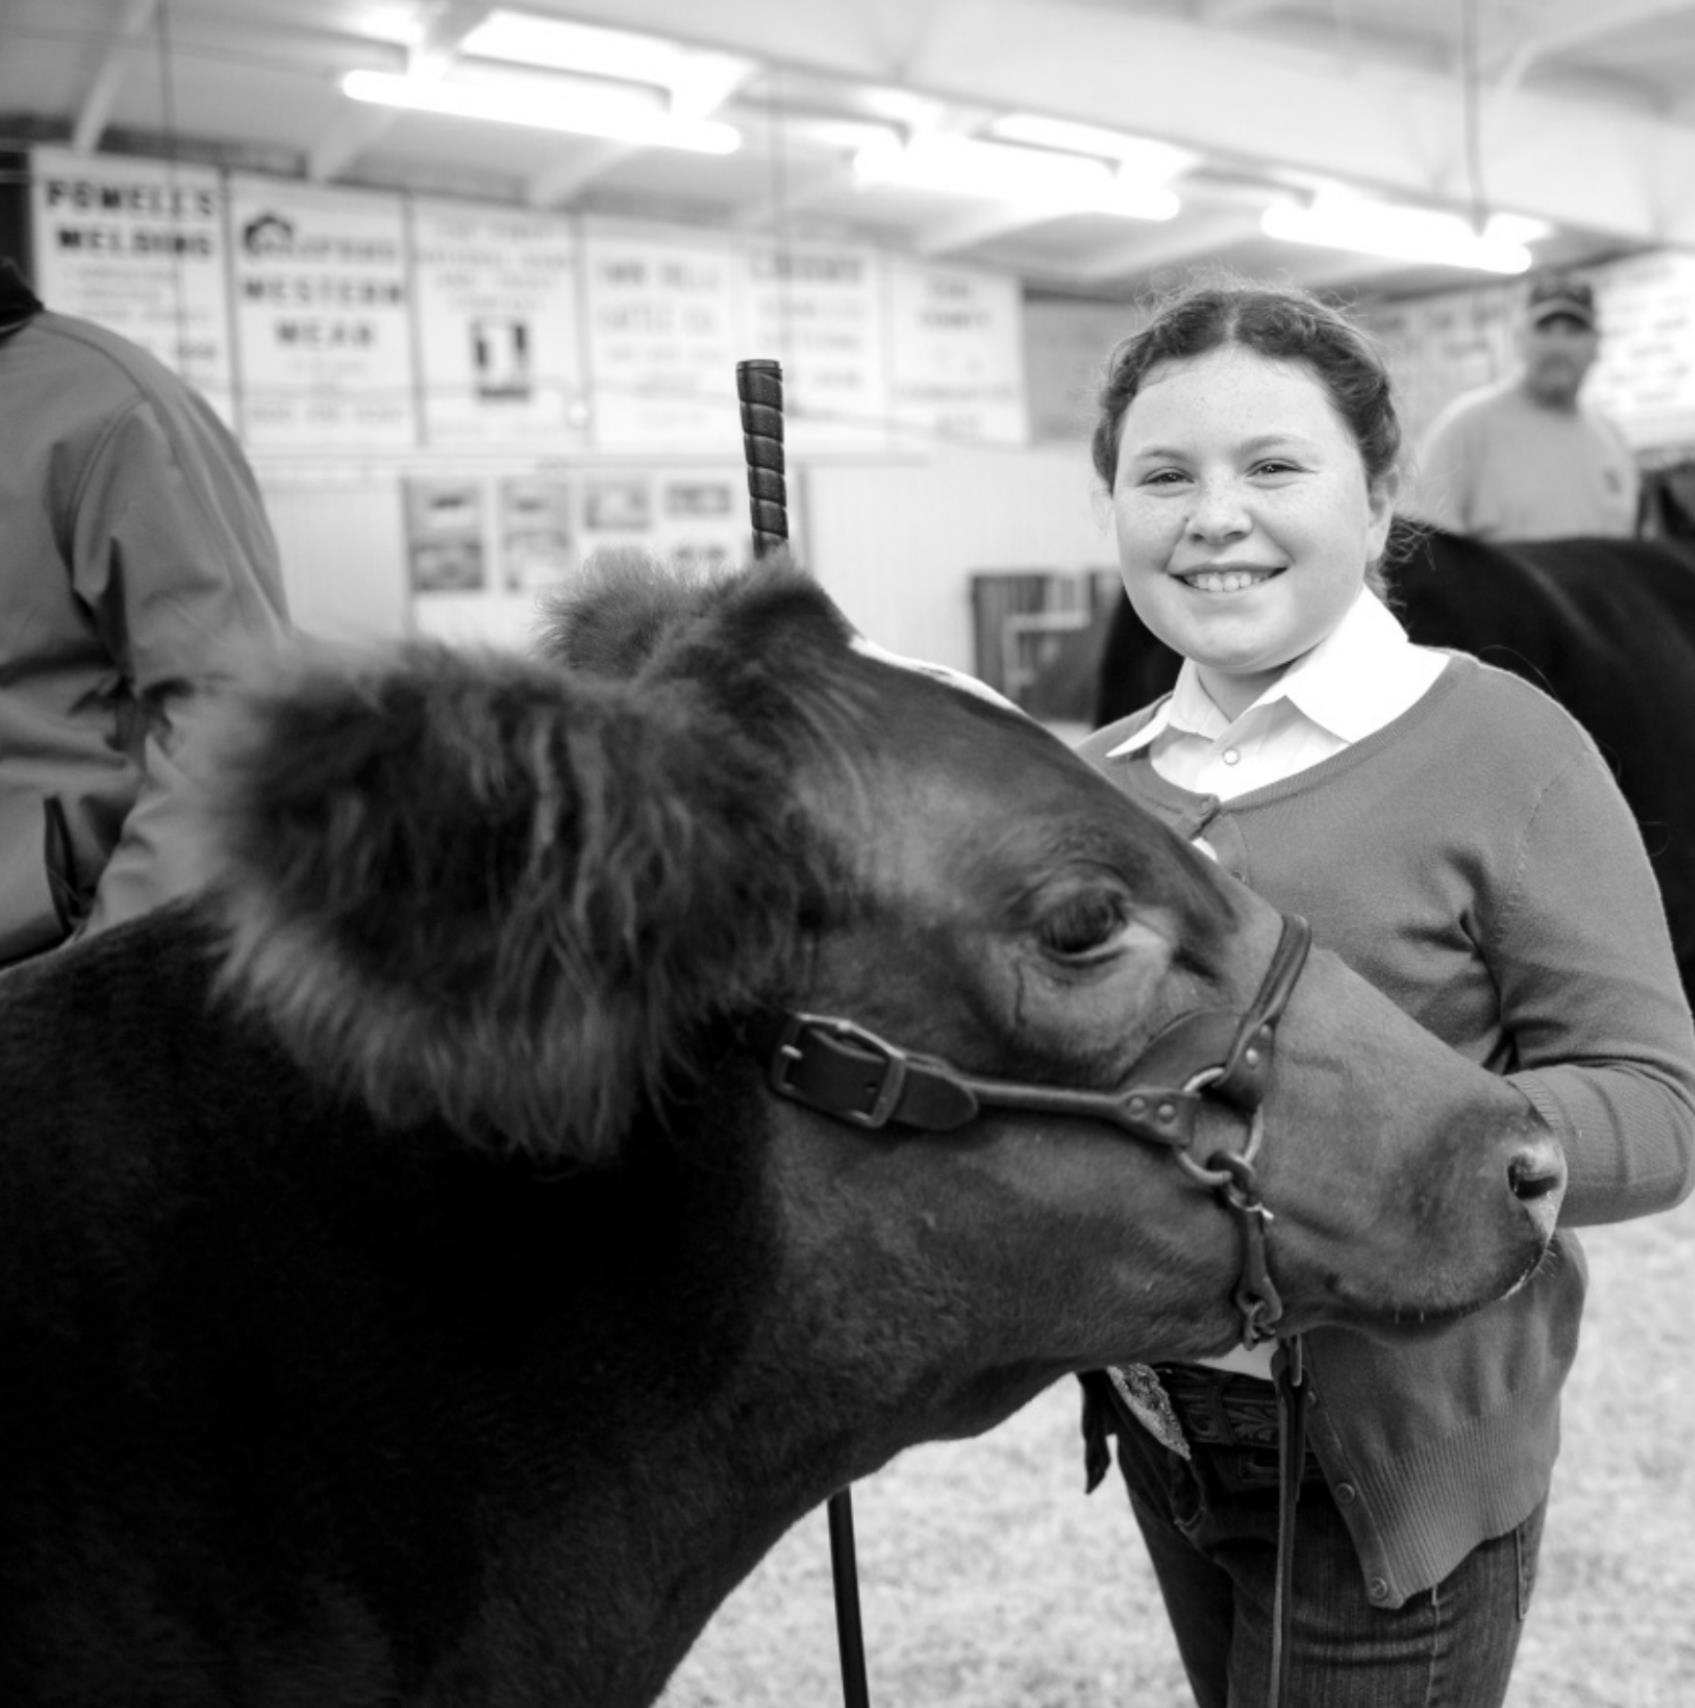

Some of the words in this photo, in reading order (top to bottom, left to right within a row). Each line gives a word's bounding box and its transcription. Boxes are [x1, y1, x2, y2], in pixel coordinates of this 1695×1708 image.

[57, 227, 212, 258] WELDING
[243, 278, 404, 305] WESTERN
[277, 320, 374, 348] WEAR
